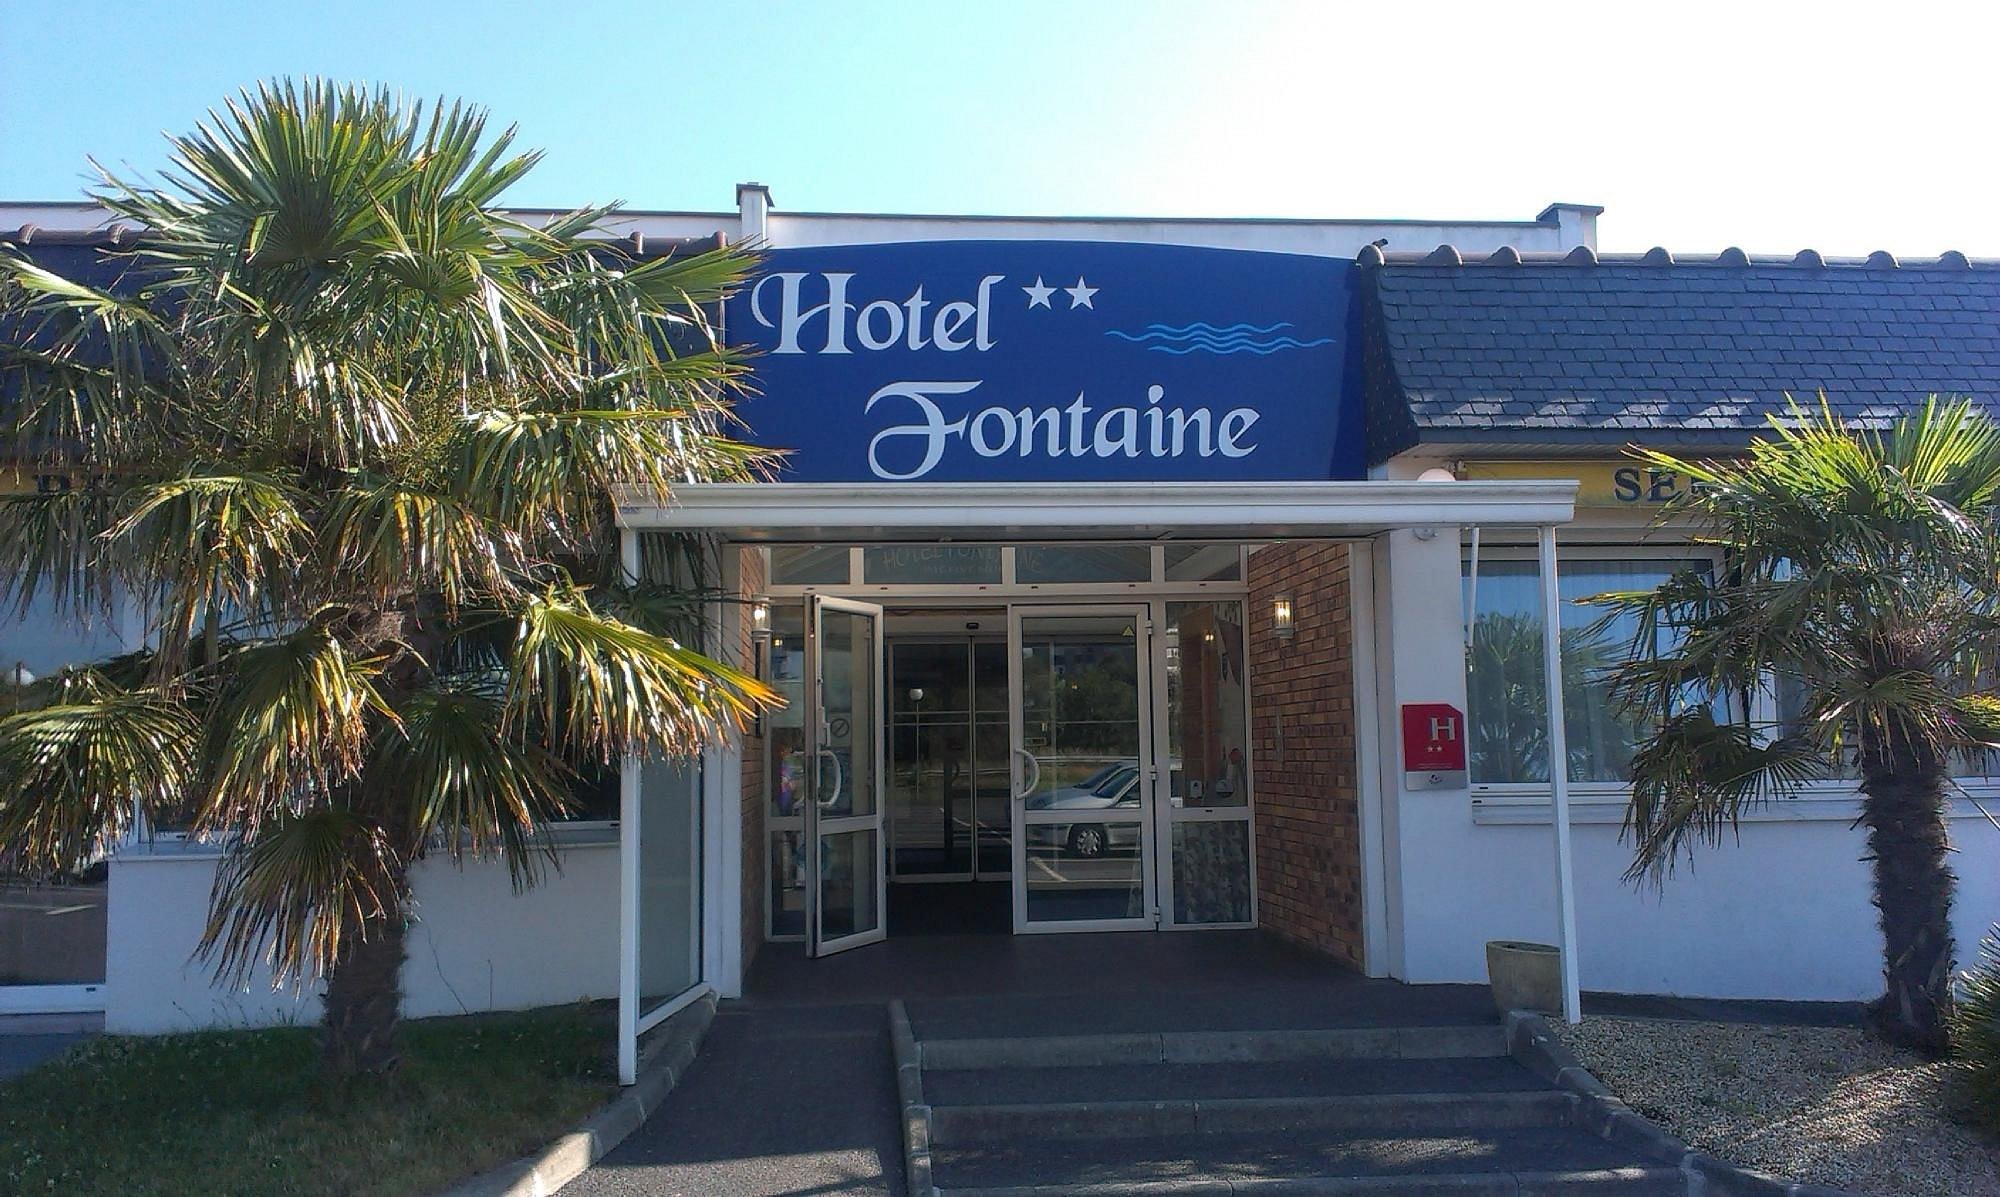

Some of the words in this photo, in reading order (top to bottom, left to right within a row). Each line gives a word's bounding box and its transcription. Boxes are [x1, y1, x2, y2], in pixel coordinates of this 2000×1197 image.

[750, 271, 1006, 354] Hotel
[864, 379, 1262, 480] Fontaine
[1430, 716, 1456, 741] H
